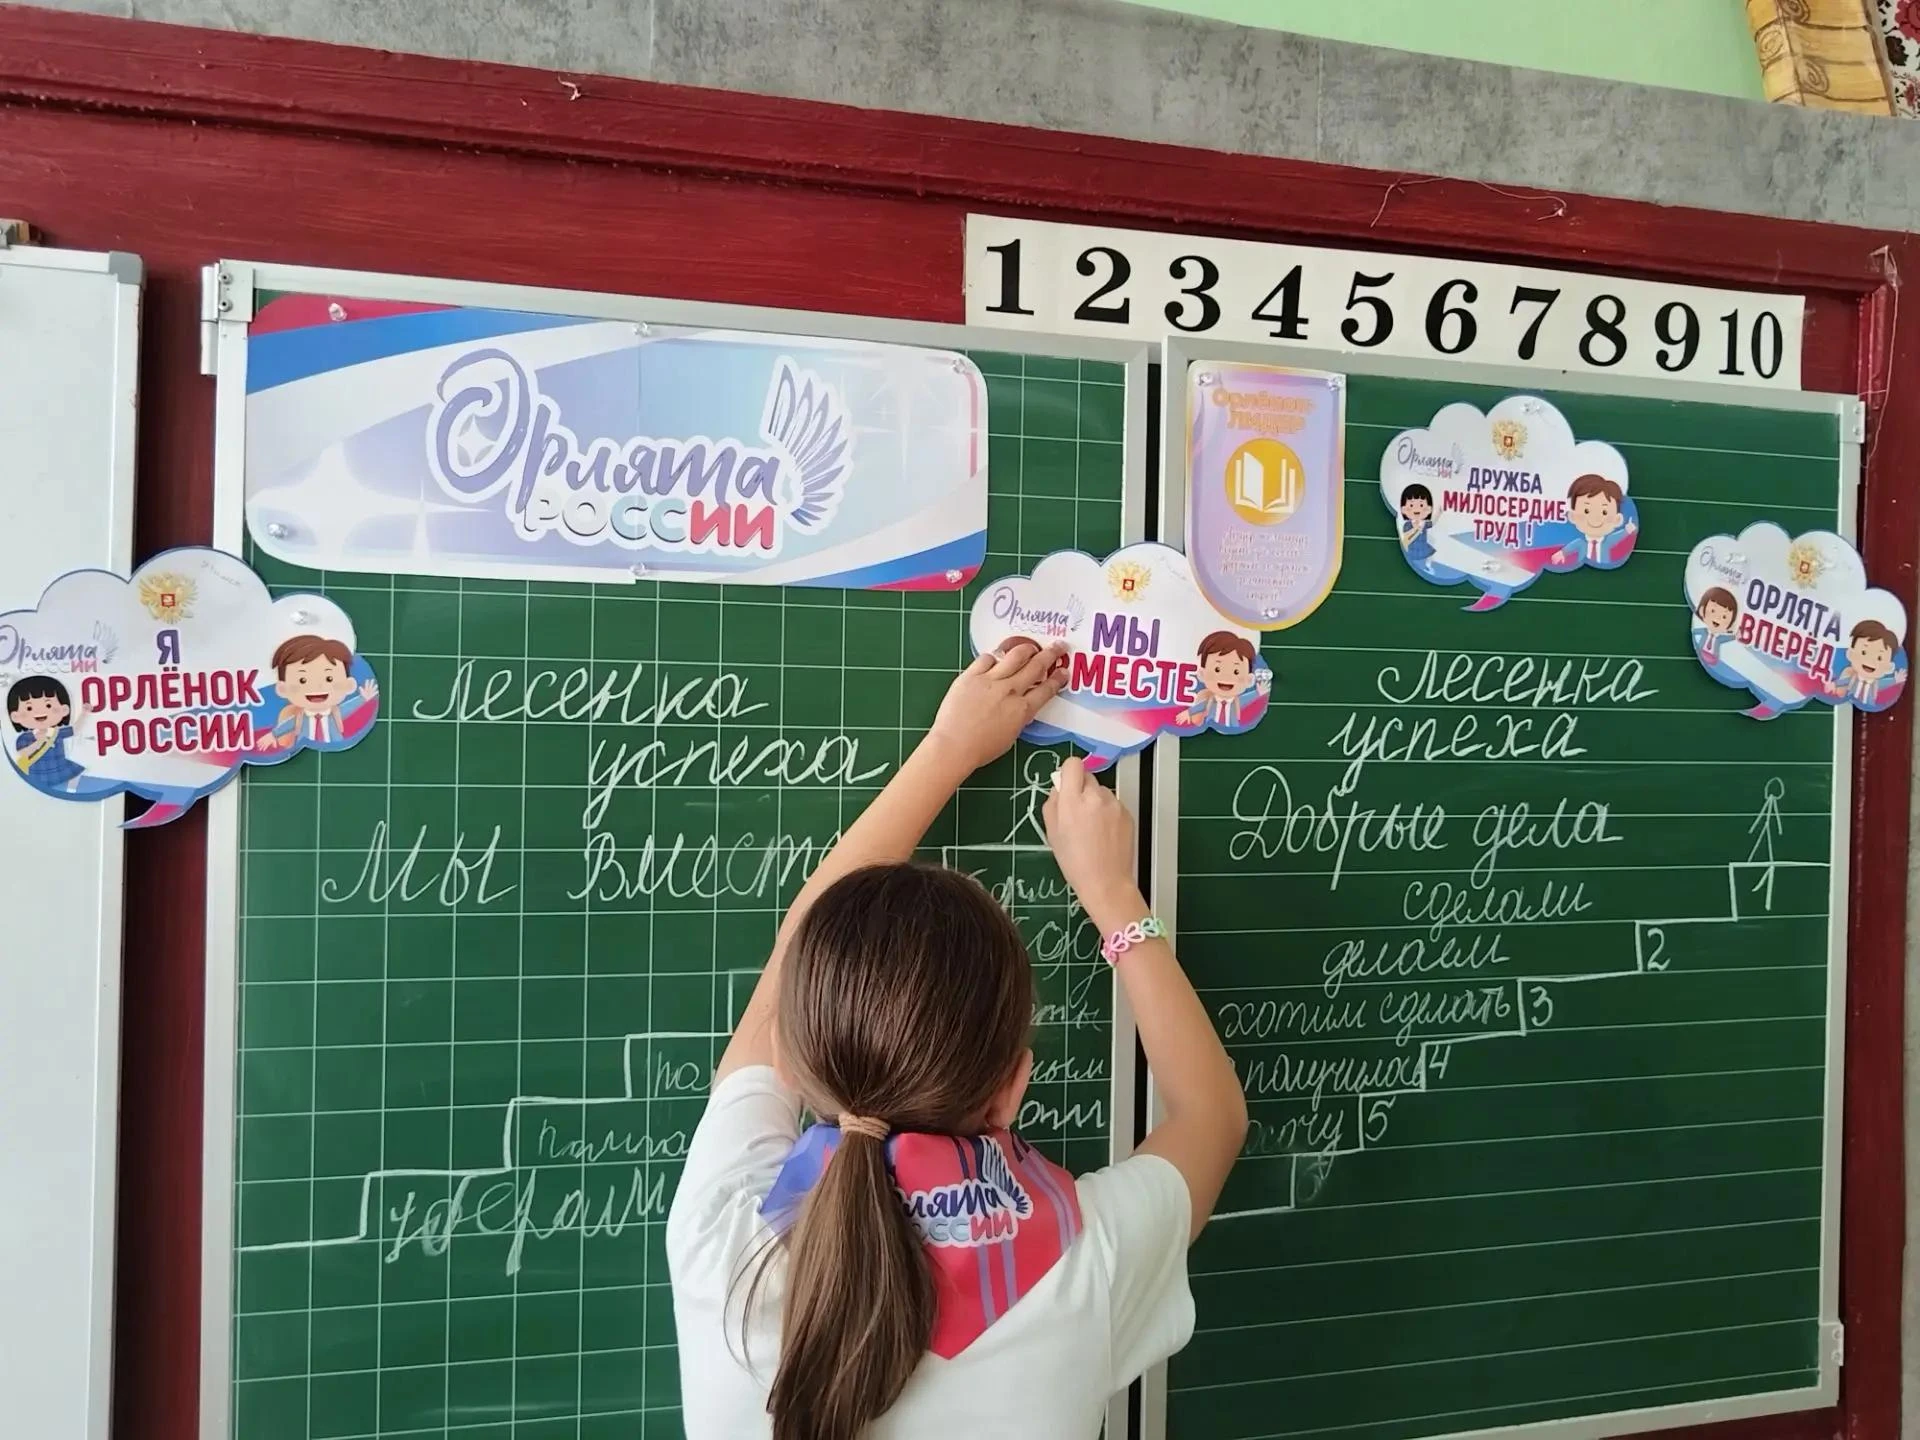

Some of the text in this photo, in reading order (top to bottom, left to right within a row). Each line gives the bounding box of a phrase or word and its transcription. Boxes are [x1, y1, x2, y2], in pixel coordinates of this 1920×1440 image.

[985, 238, 1783, 379] 1 2 3 4 5 6 7 8 9 10
[436, 348, 779, 513] Орлята
[1467, 467, 1542, 494] ДРУЖБА
[524, 498, 774, 550] РОССИИ
[1443, 490, 1567, 522] МИЛОСЕРДИЕ
[1474, 519, 1519, 547] ТРУД
[993, 586, 1070, 625] Орлята
[1746, 579, 1841, 642] ОРЛЯТА
[157, 629, 180, 665] Я
[1092, 612, 1161, 658] МЫ
[1738, 613, 1834, 682] ВПЕРЁД
[81, 667, 260, 712] ОРЛЁНОК
[96, 713, 251, 756] РОССИИ
[1229, 766, 1624, 890] Добрые дела
[321, 820, 517, 906] Мы
[1752, 866, 1774, 911] 1
[1646, 928, 1670, 970] 2
[1530, 993, 1553, 1027] 3
[1429, 1045, 1451, 1079] 4
[1366, 1096, 1397, 1141] 5
